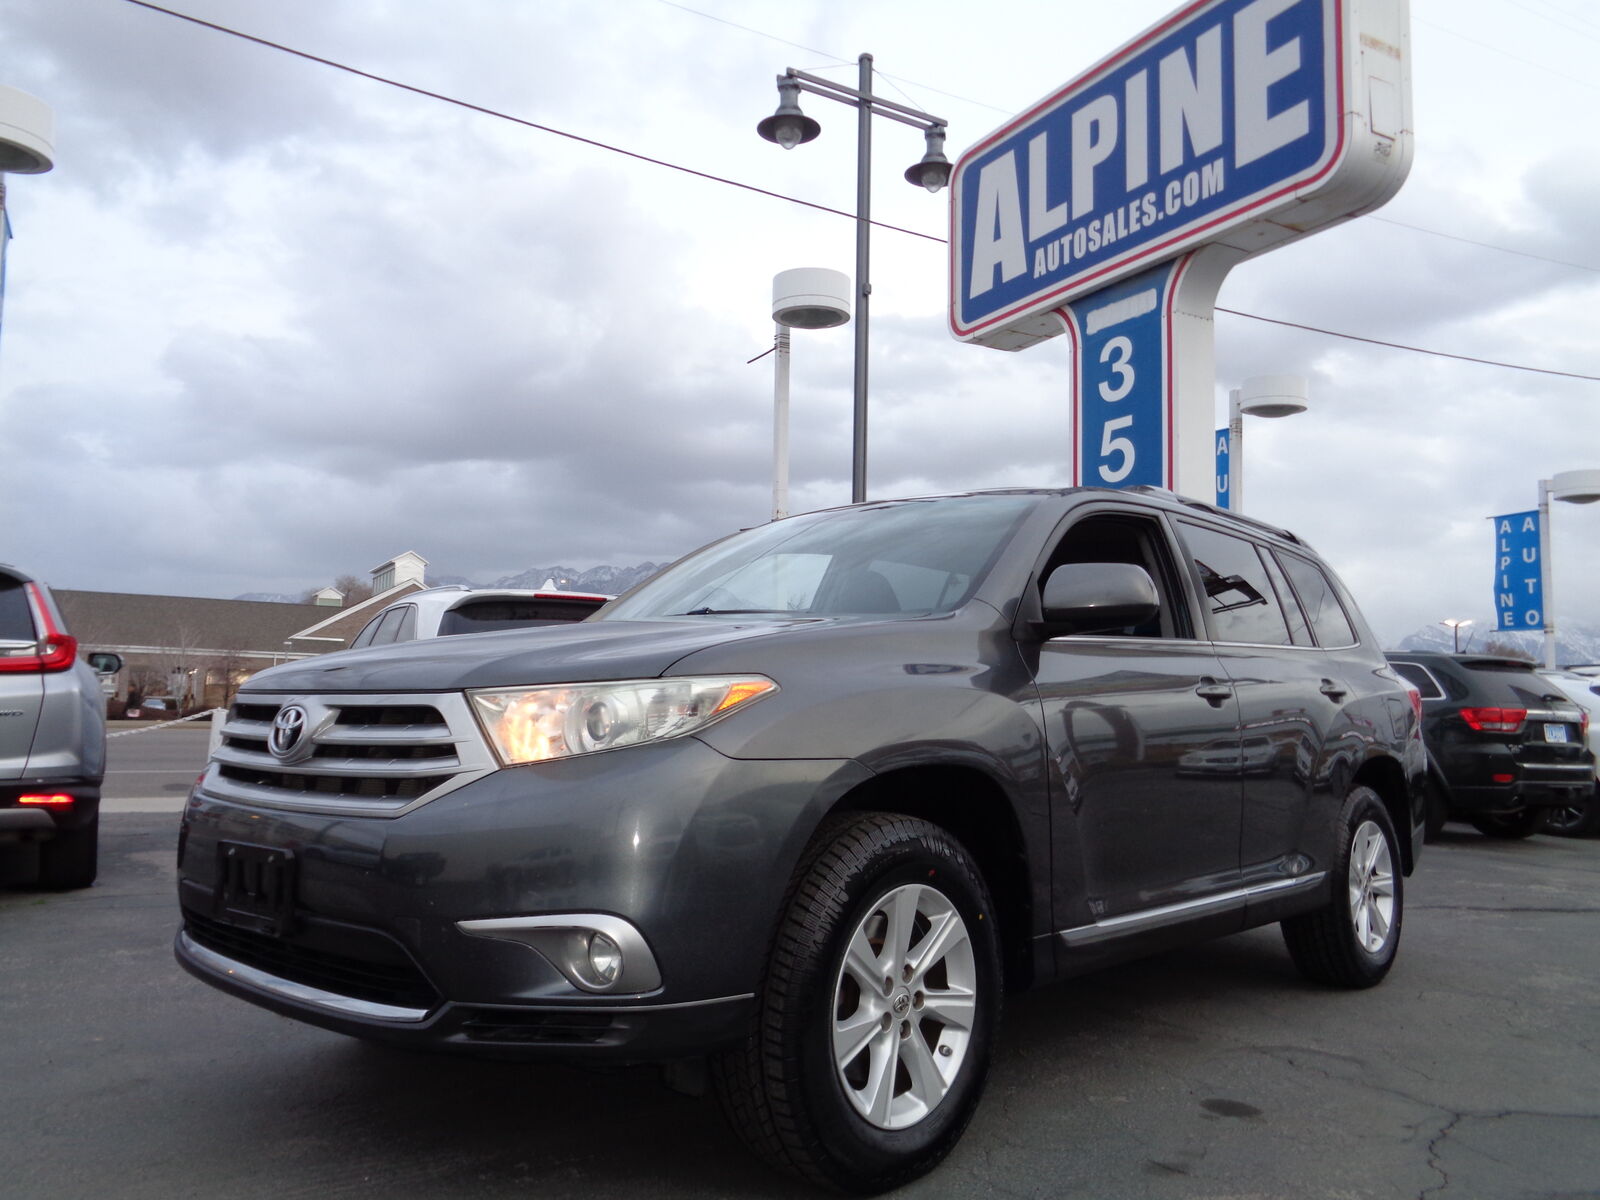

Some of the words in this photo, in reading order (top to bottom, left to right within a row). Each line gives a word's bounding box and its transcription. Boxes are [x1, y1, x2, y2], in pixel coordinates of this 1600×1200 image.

[970, 0, 1310, 300] ALPINE
[1033, 158, 1225, 279] AUTOSALES.COM
[1500, 519, 1515, 627] ALPINE
[1522, 516, 1540, 626] AUTO
